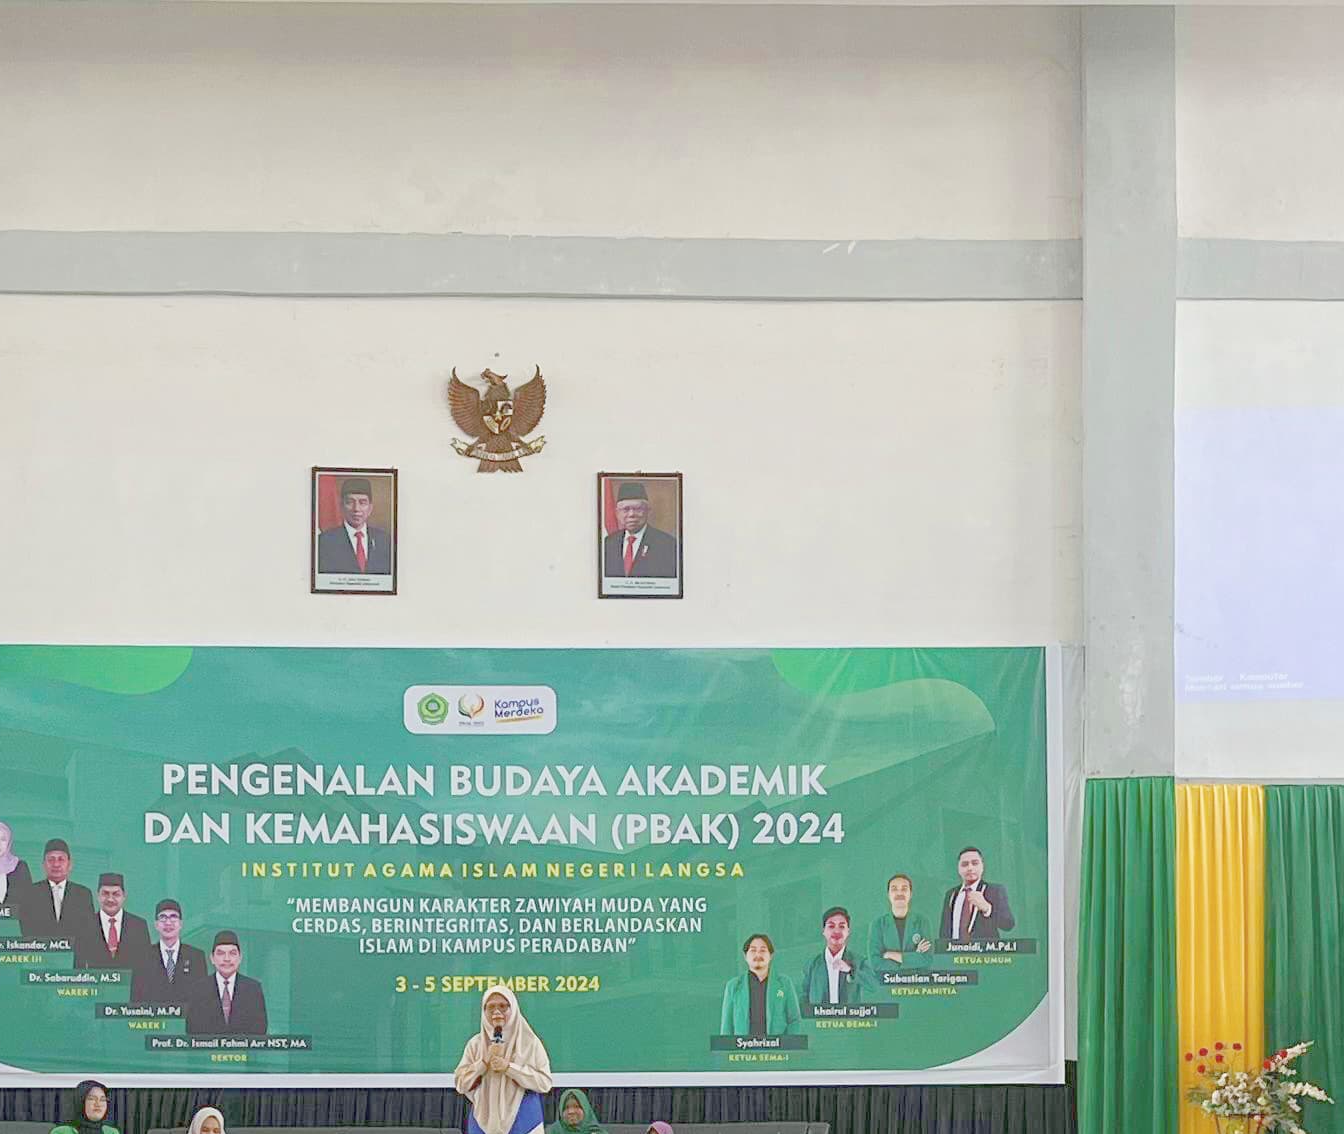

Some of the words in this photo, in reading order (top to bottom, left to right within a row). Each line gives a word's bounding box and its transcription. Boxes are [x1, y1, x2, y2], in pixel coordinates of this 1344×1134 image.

[495, 698, 540, 710] Kampus
[495, 706, 544, 718] Merdeka
[163, 763, 434, 797] PENGENALAN
[450, 764, 607, 797] BUDAYA
[616, 764, 827, 796] AKADEMIK
[144, 812, 230, 844] DAN
[245, 812, 597, 845] KEMAHASISWAAN
[611, 813, 740, 850] (PBAK)
[752, 812, 845, 844] 2024
[241, 862, 355, 878] INSTITUT
[363, 862, 453, 878] AGAMA
[462, 862, 538, 878] ISLAM
[546, 862, 636, 878] NEGERI
[644, 862, 745, 878] LANGSA
[419, 898, 511, 914] KARAKTER
[515, 898, 597, 914] ZAWIYAH
[601, 898, 655, 914] MUDA
[659, 898, 708, 914] YANG
[292, 918, 367, 936] CERDAS,
[371, 918, 514, 936] BERINTEGRITAS,
[519, 918, 557, 934] DAN
[562, 918, 703, 933] BERLANDASKAN
[49, 940, 72, 950] MCL
[359, 938, 415, 953] ISLAM
[419, 938, 437, 953] DI
[442, 938, 516, 953] KAMPUS
[946, 942, 983, 953] Junaidi,
[32, 955, 43, 964] III
[954, 956, 982, 965] KETUA
[984, 956, 1012, 965] UMUM
[29, 973, 43, 983] Dr.
[101, 973, 121, 983] M.Si
[883, 973, 929, 983] Subastian
[932, 973, 968, 985] Tarigan
[395, 976, 408, 992] 3
[424, 976, 436, 992] 5
[441, 976, 550, 992] SEPTEMBER
[555, 976, 600, 992] 2024
[57, 987, 90, 997] WAREK
[891, 987, 920, 996] KETUA
[921, 987, 957, 996] PANITIA
[105, 1006, 119, 1016] Dr.
[157, 1006, 181, 1016] M.Pd
[814, 1006, 847, 1016] khairul
[128, 1021, 160, 1030] WAREK
[816, 1020, 844, 1029] KETUA
[152, 1038, 174, 1048] Prof.
[176, 1038, 190, 1048] Dr.
[221, 1038, 249, 1048] Fahmi
[267, 1038, 288, 1049] NST,
[289, 1038, 307, 1048] MA
[736, 1037, 779, 1050] Syahrizal
[211, 1054, 248, 1062] REKTOR
[729, 1053, 757, 1062] KETUA
